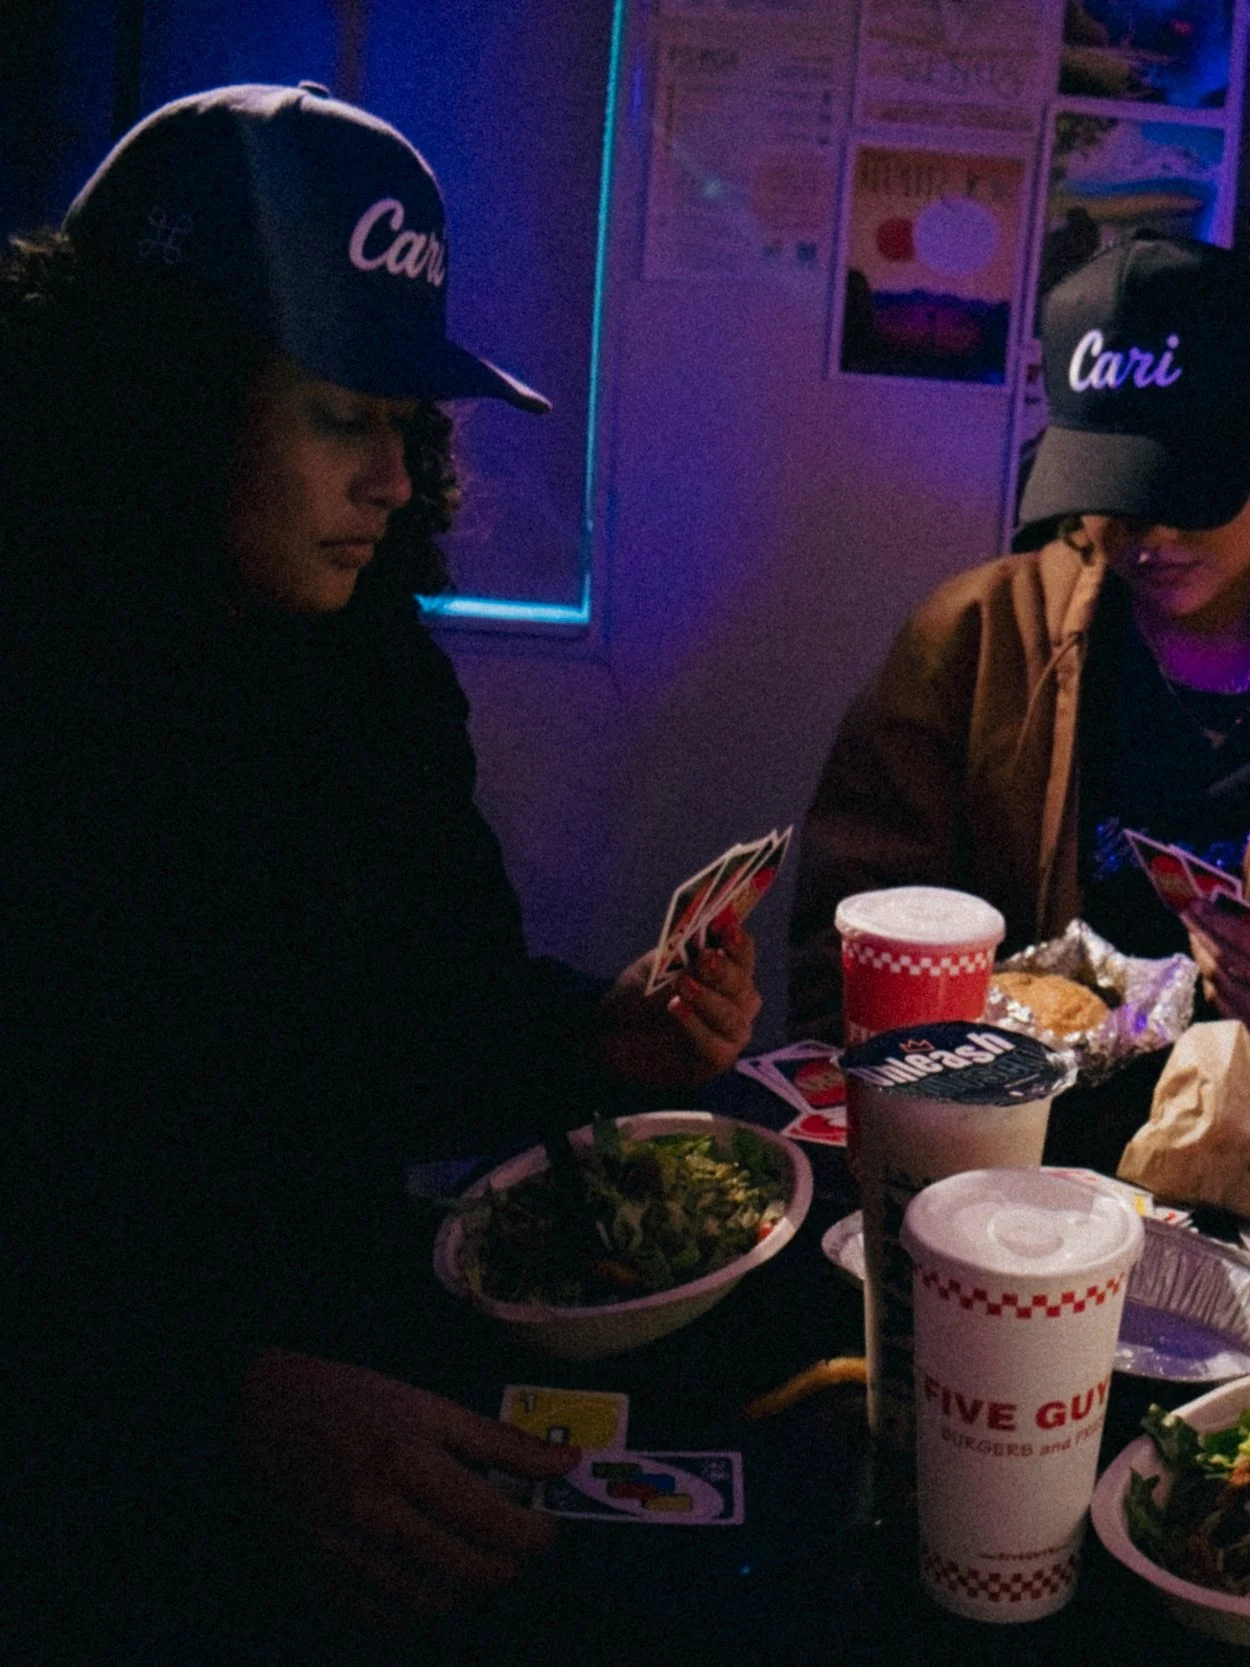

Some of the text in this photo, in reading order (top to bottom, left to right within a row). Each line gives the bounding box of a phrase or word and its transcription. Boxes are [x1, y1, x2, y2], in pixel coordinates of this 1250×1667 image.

[1068, 328, 1183, 393] Cari
[847, 1031, 1016, 1088] Unleash
[924, 1374, 1017, 1432] FIVE
[941, 1426, 1034, 1458] BURGERS
[1040, 1437, 1071, 1457] and
